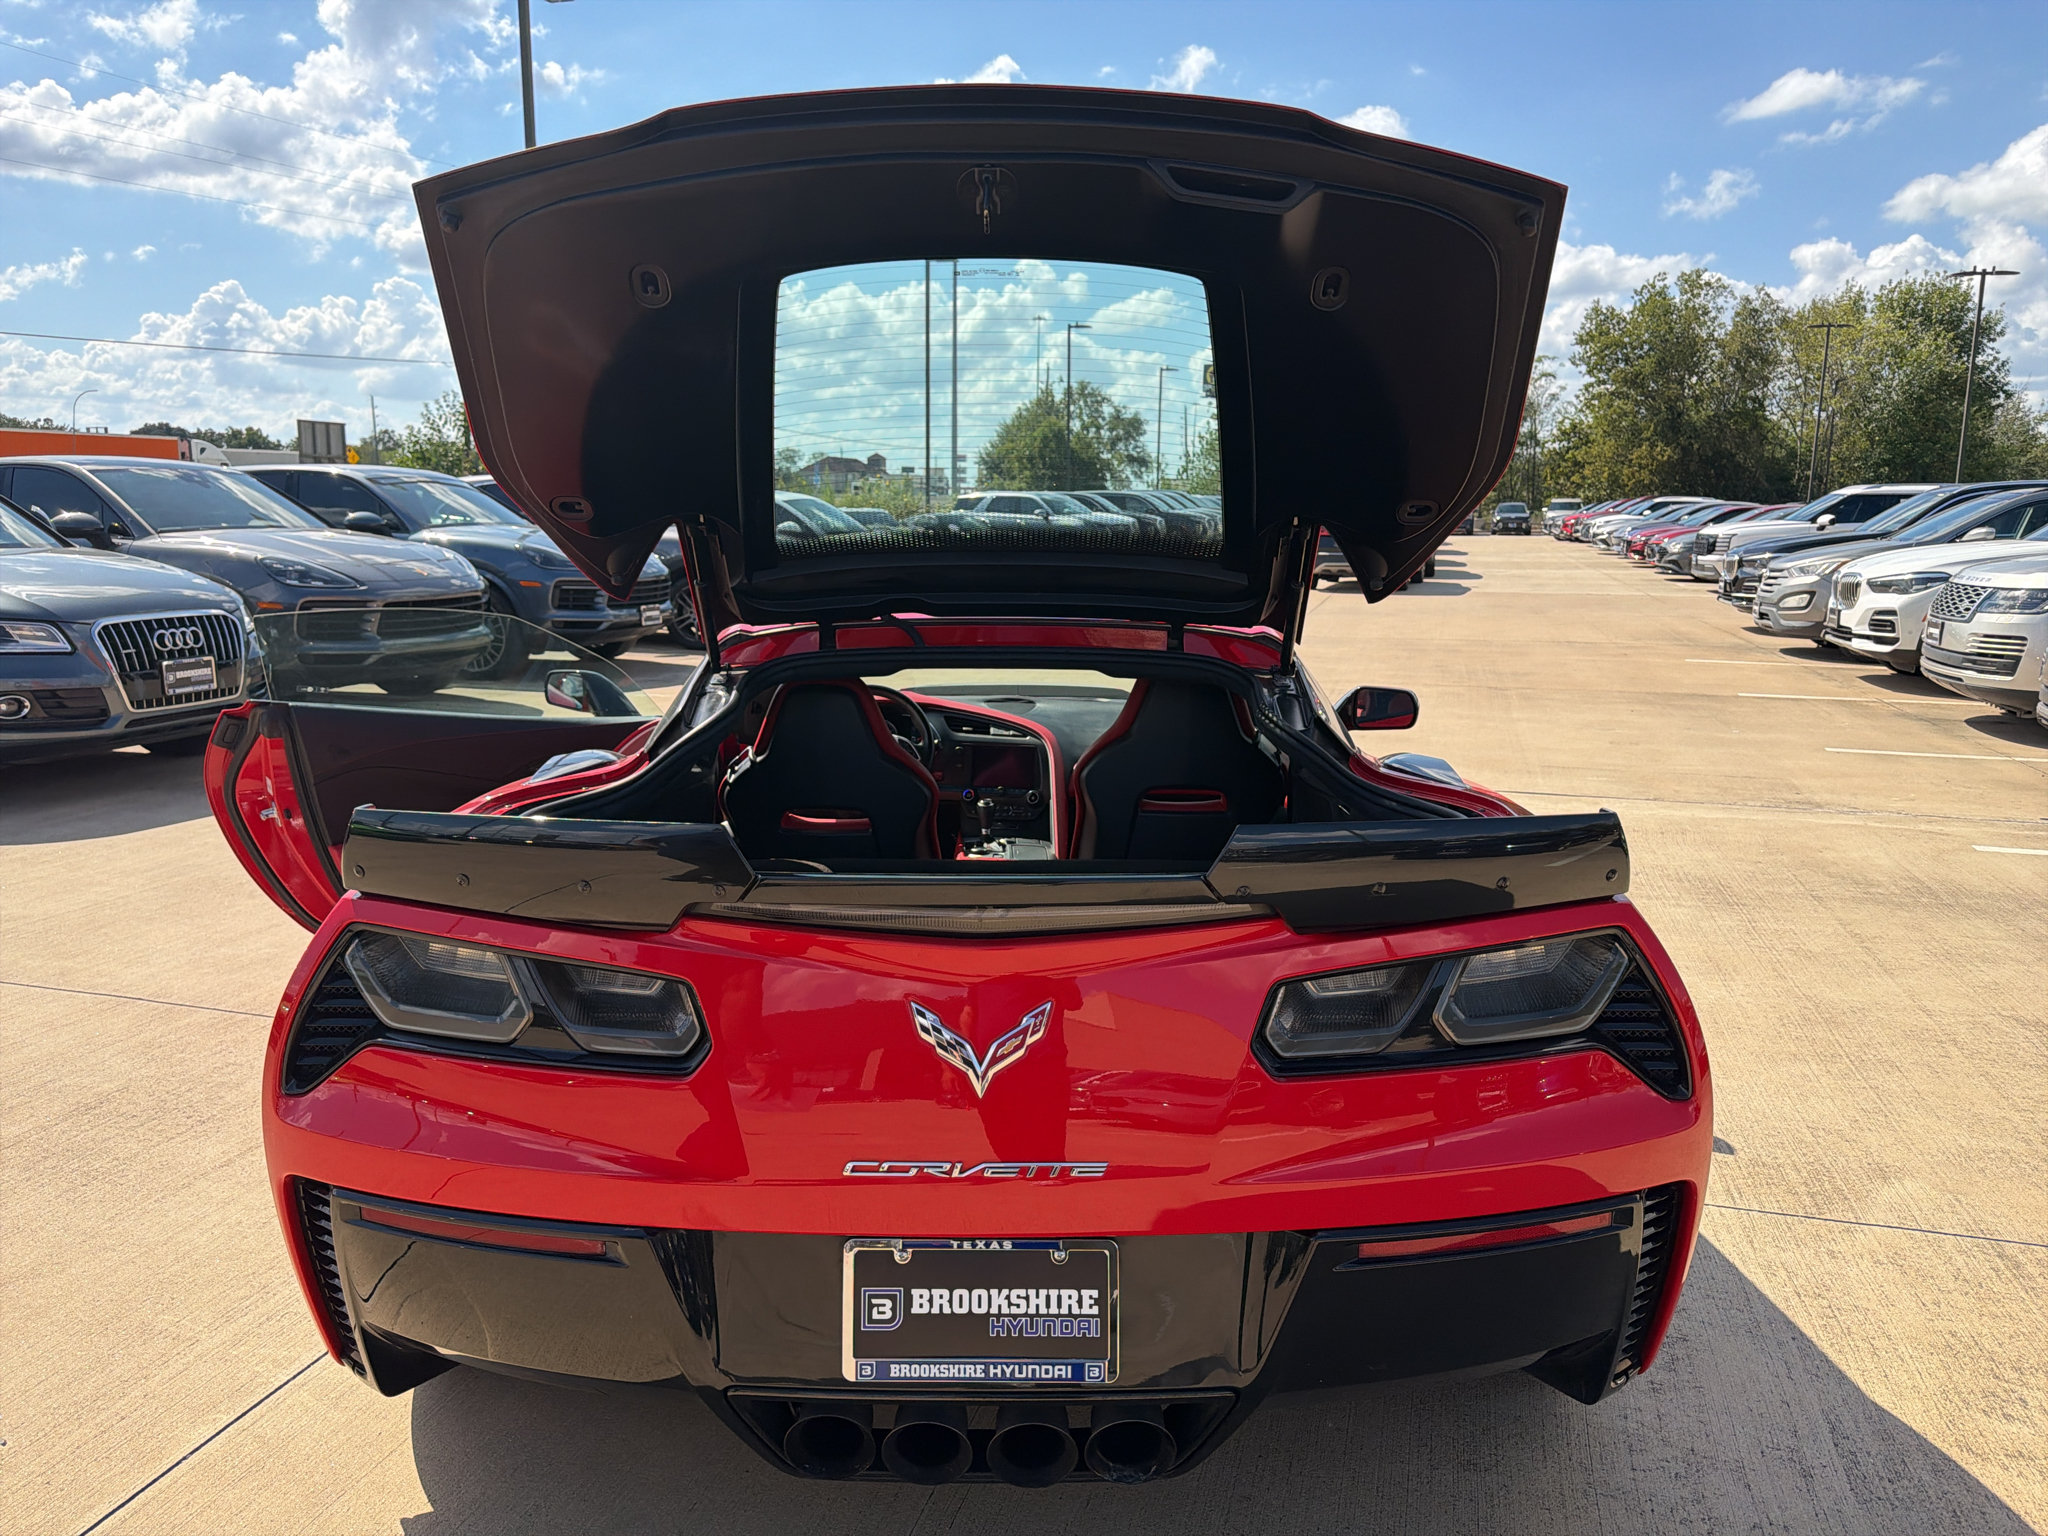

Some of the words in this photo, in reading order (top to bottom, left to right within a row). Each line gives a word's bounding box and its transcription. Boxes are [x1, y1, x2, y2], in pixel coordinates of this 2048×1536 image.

[842, 1161, 1110, 1178] CORVETTE
[951, 1240, 1013, 1250] TEXAS
[911, 1288, 1099, 1315] BROOKSHIRE
[989, 1317, 1101, 1338] HYUNDAI
[889, 1363, 985, 1378] BROOKSHIRE
[989, 1364, 1072, 1379] HYUNDAI
